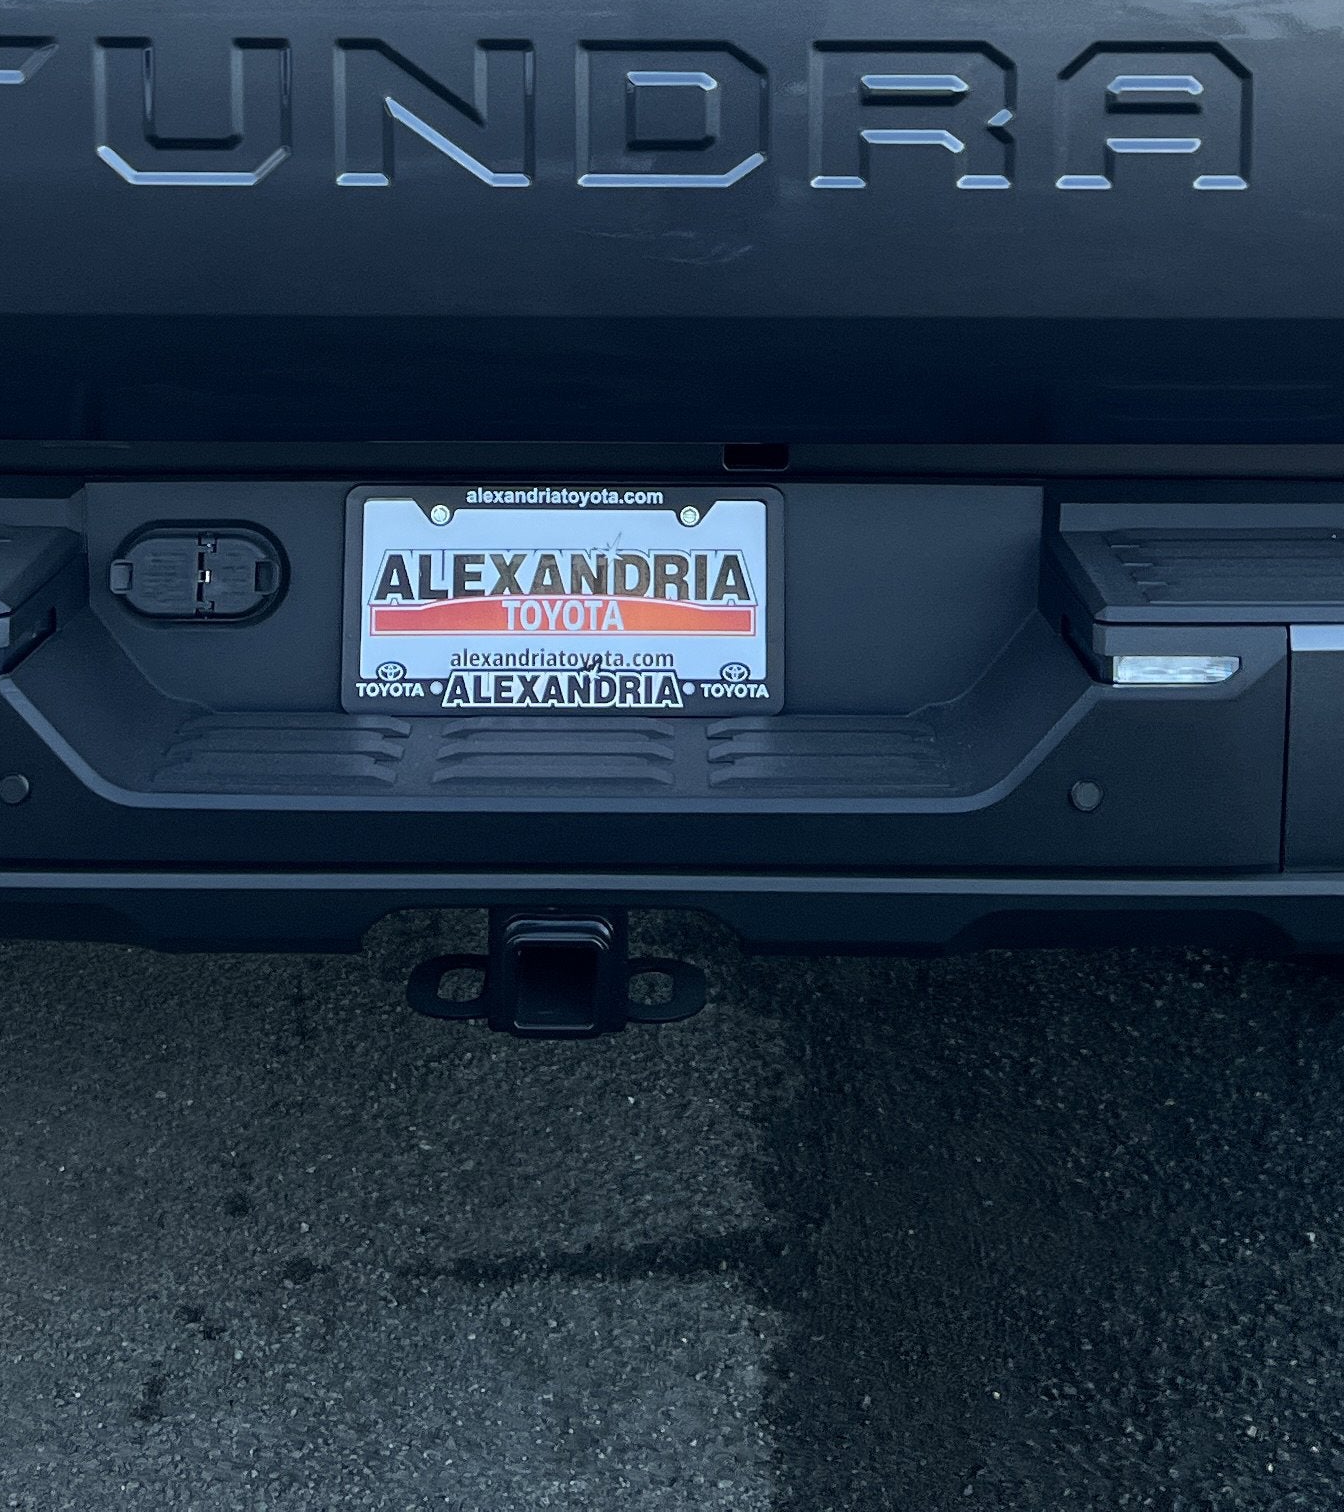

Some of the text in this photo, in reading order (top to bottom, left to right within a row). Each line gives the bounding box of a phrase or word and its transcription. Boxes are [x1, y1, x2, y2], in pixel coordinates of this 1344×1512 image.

[465, 488, 664, 507] alexandriatoyota.com
[373, 550, 752, 602] ALEXANDRIA
[501, 599, 625, 632] TOYOTA
[449, 648, 674, 669] alexandriatoyota.com
[356, 682, 424, 699] TOYOTA
[443, 672, 682, 706] ALEXANDRIA
[700, 682, 769, 699] TOYOTA
